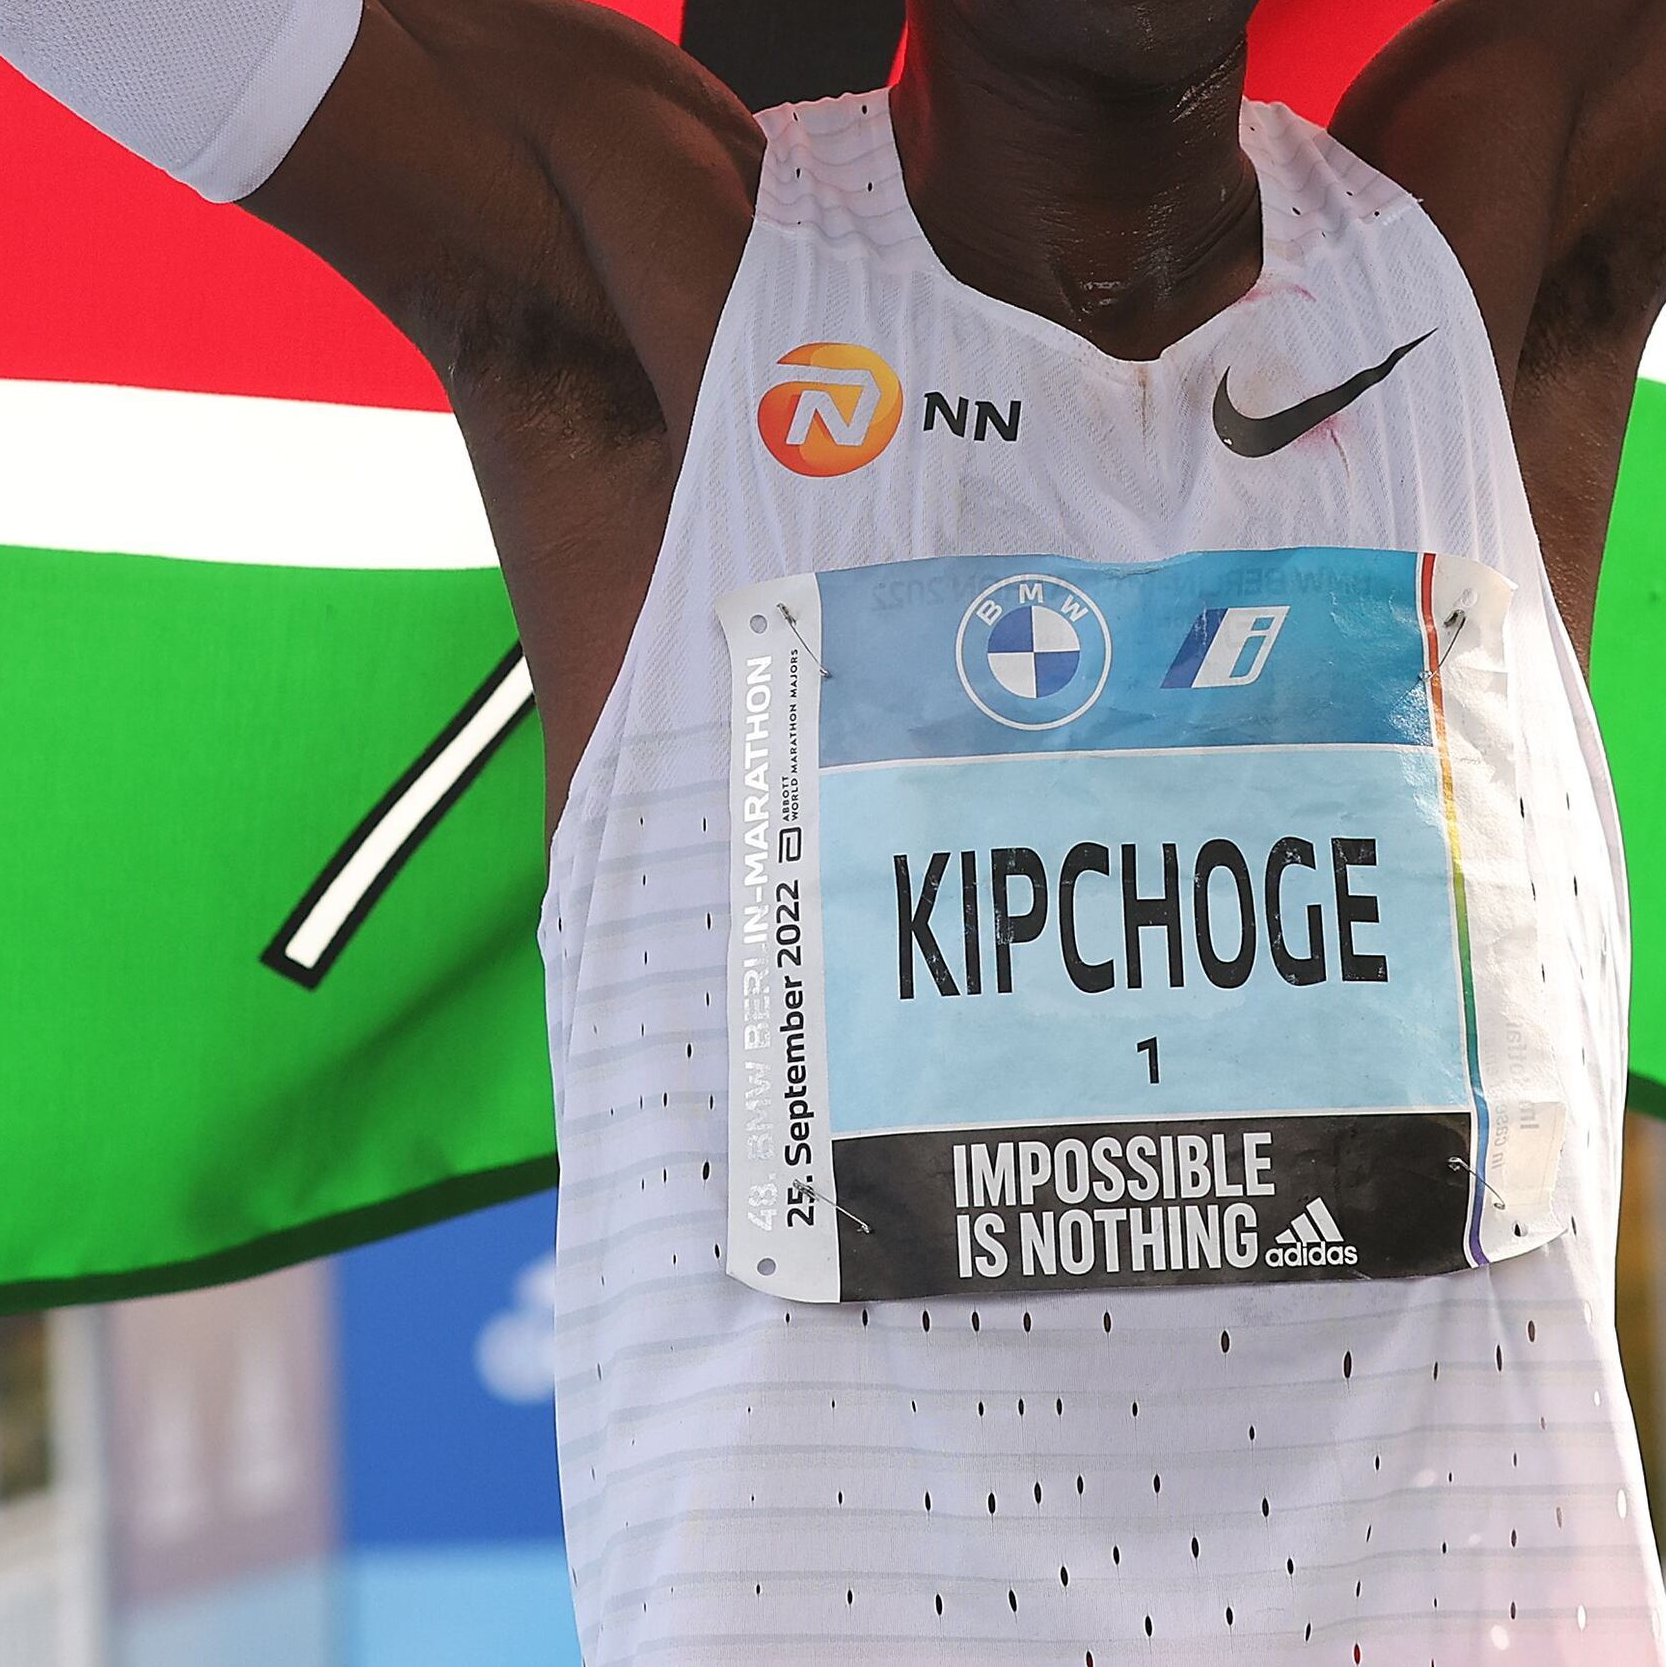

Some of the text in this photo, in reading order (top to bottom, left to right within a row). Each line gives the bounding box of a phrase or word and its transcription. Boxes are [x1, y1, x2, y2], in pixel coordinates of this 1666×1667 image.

[923, 391, 1022, 442] NN
[976, 583, 1089, 626] BMW
[789, 648, 799, 822] WORLD MARATHON MAJORS
[782, 776, 790, 822] ABBOTT
[893, 836, 1389, 1000] KIPCHOGE
[776, 879, 816, 1228] 25. September 2022
[1136, 1036, 1160, 1085] 1
[952, 1132, 1276, 1208] IMPOSSIBLE
[956, 1202, 1259, 1278] IS NOTHING
[1264, 1242, 1359, 1267] adidas
